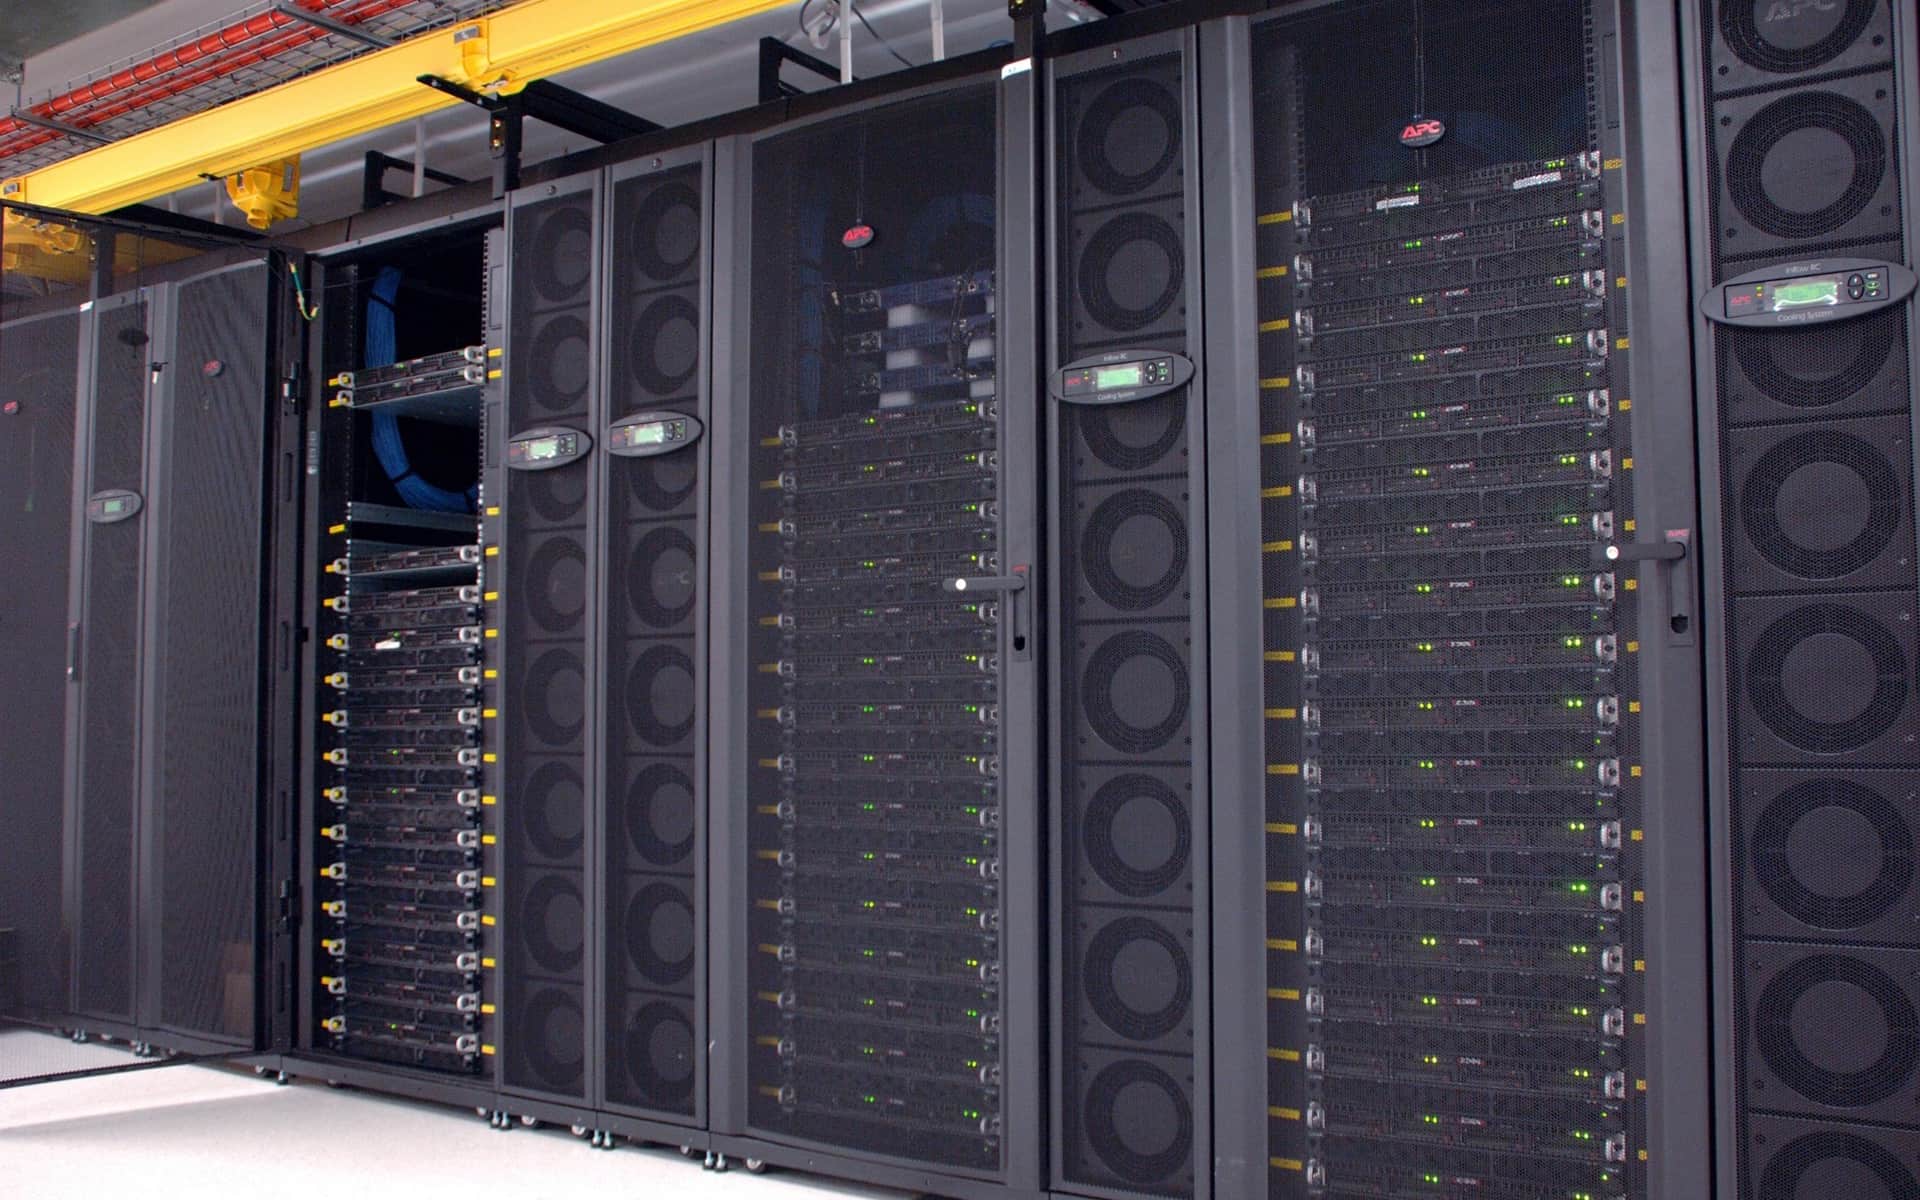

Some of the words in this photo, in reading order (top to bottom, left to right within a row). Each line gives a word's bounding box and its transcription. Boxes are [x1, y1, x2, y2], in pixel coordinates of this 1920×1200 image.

[1402, 121, 1441, 139] APC
[843, 226, 871, 241] APC
[1777, 311, 1806, 323] Cooling
[1807, 310, 1833, 321] System
